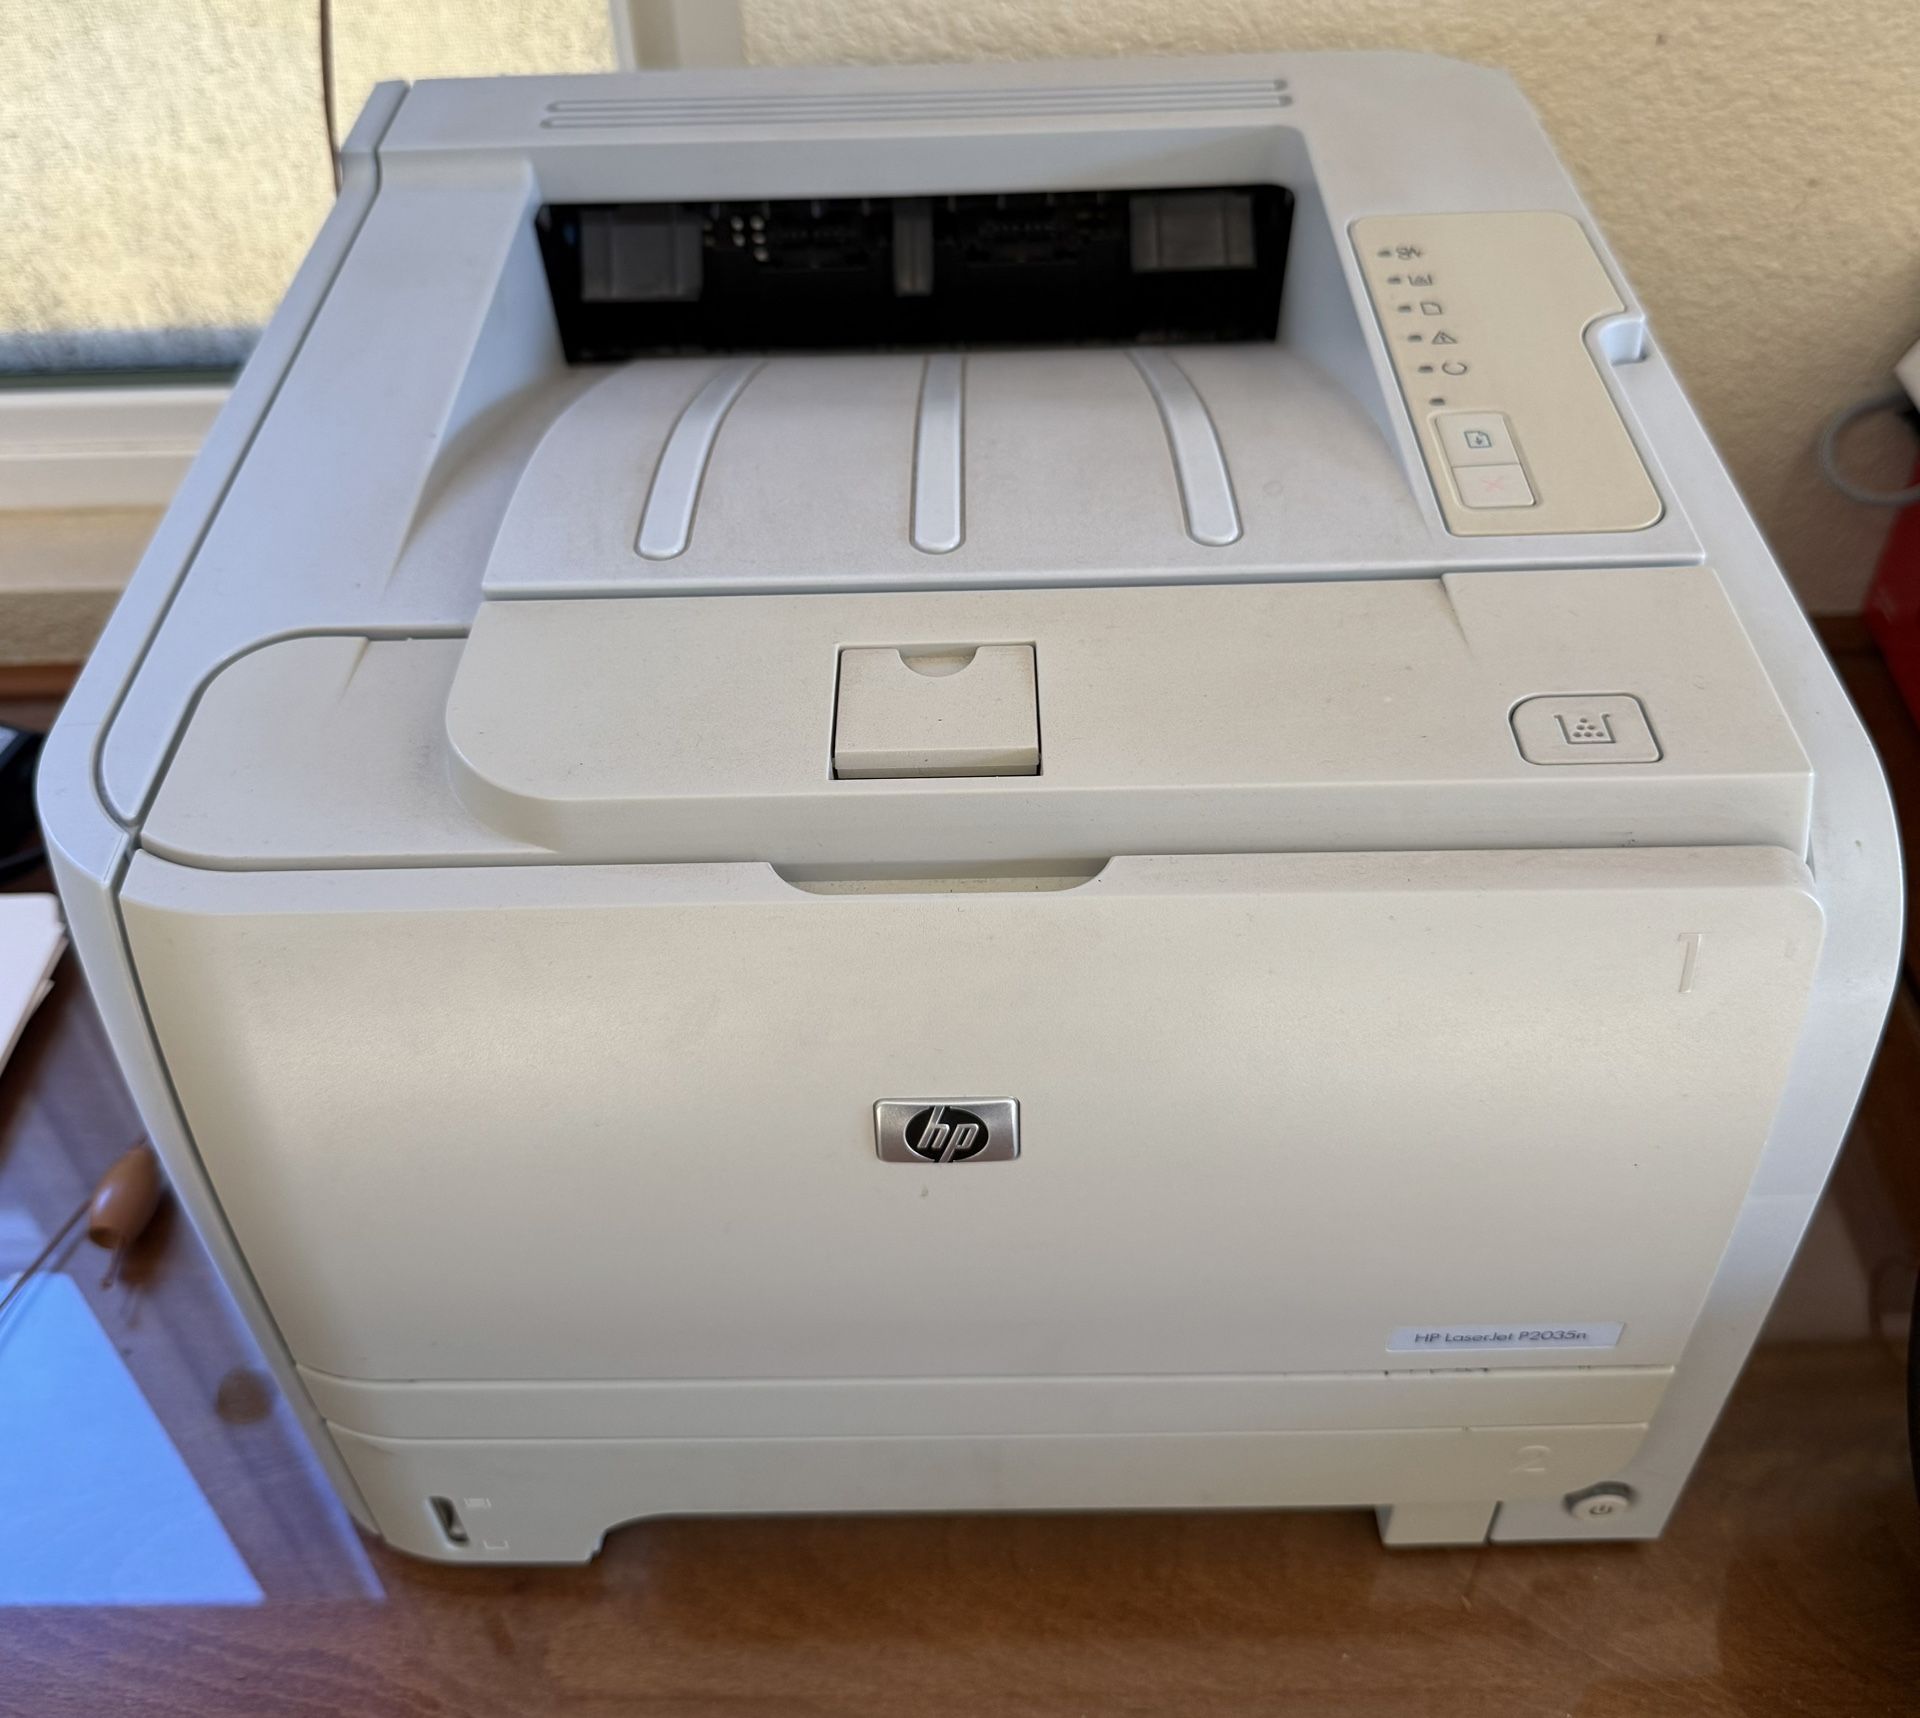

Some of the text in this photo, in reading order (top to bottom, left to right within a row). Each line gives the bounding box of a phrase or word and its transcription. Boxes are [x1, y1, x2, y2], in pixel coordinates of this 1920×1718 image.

[916, 1105, 979, 1163] hp
[1414, 1329, 1587, 1343] HP LaserJet P2035n
